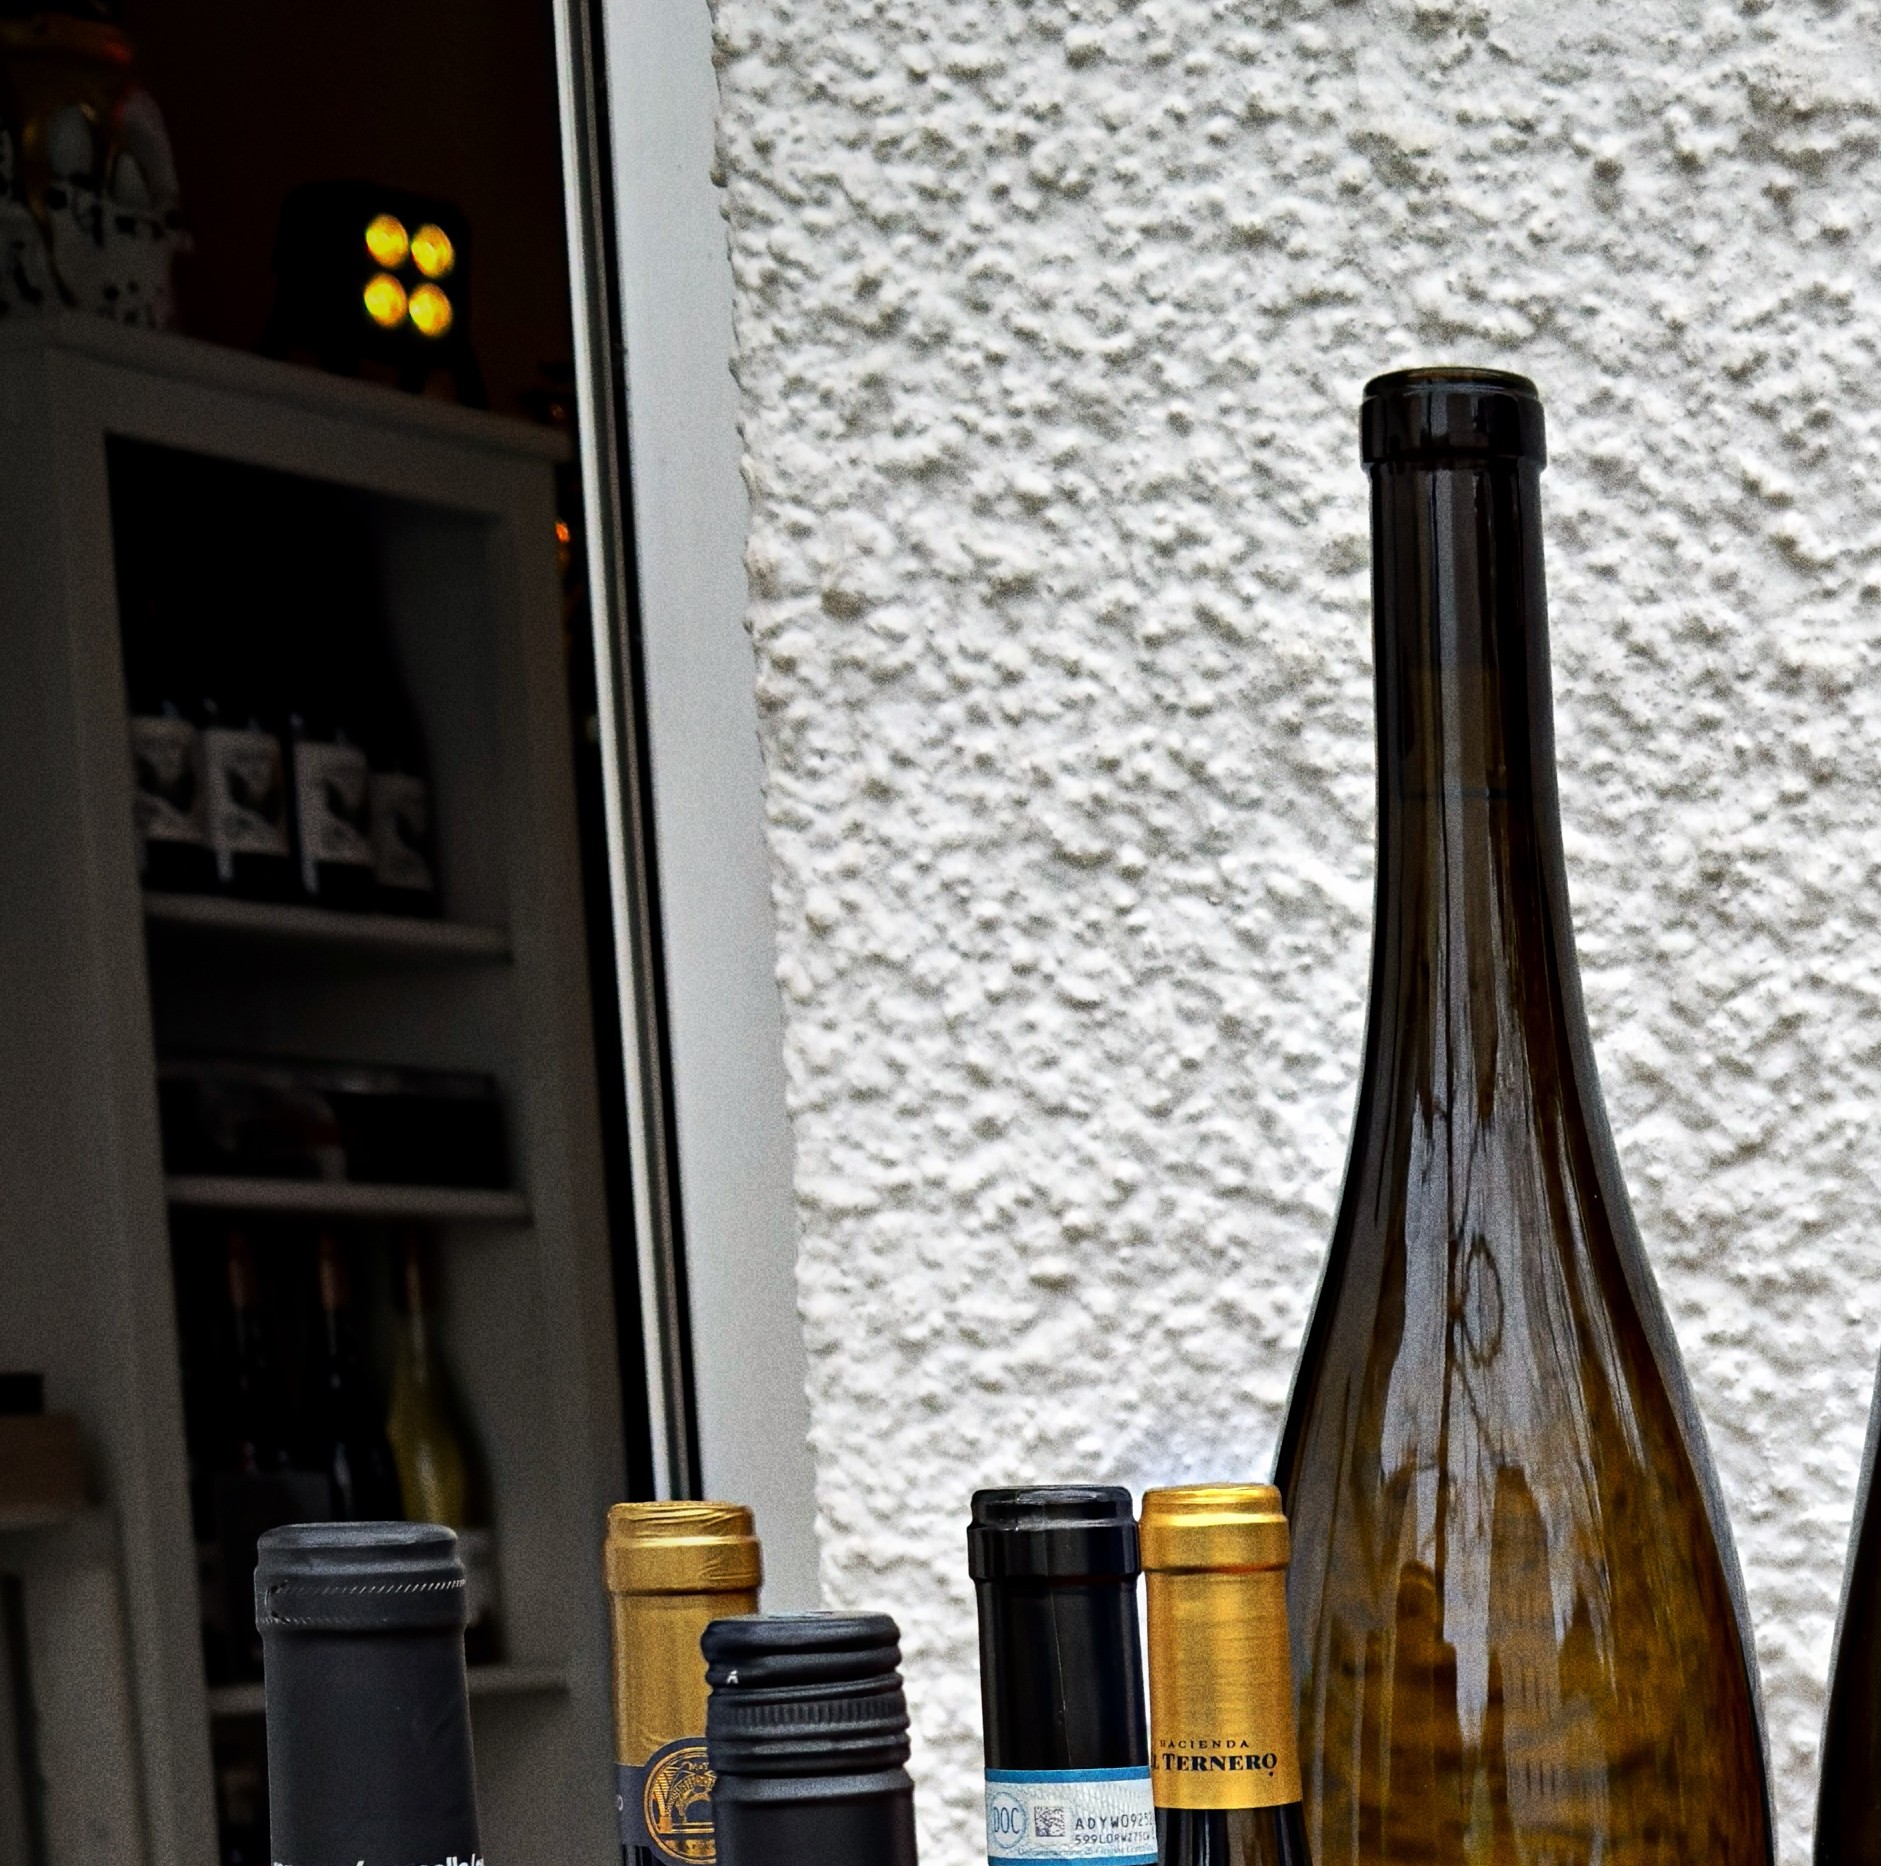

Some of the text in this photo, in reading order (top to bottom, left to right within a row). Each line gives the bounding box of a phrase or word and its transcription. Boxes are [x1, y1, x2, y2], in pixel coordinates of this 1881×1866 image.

[1160, 1739, 1249, 1749] HACIENDA
[1163, 1752, 1278, 1777] TERNERO
[993, 1806, 1020, 1835] DOC
